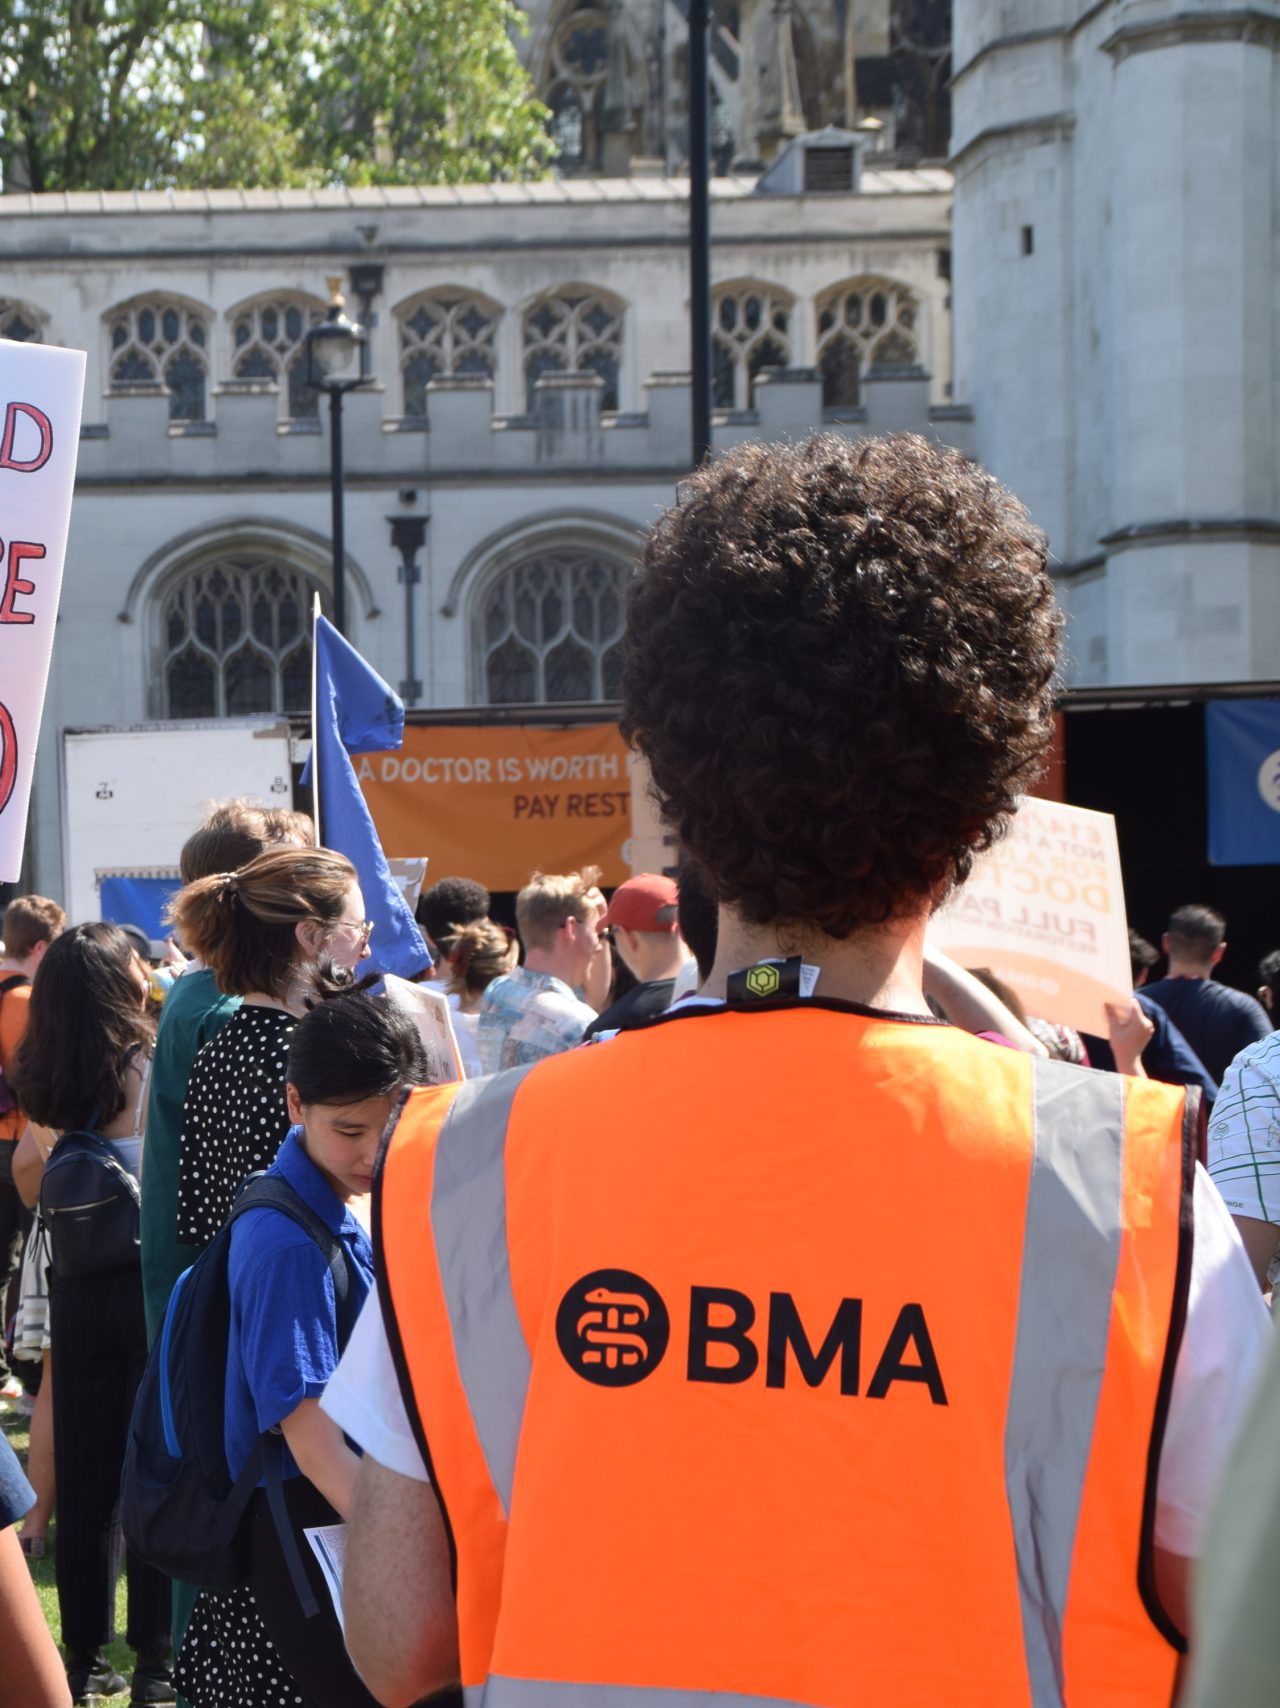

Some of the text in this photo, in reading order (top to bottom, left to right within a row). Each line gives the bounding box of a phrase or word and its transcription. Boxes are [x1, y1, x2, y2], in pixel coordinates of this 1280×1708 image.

[358, 756, 377, 783] A
[381, 756, 493, 784] DOCTOR
[496, 756, 523, 784] IS
[524, 753, 618, 783] WORTH
[513, 793, 560, 819] PAY
[686, 1285, 949, 1407] BMA
